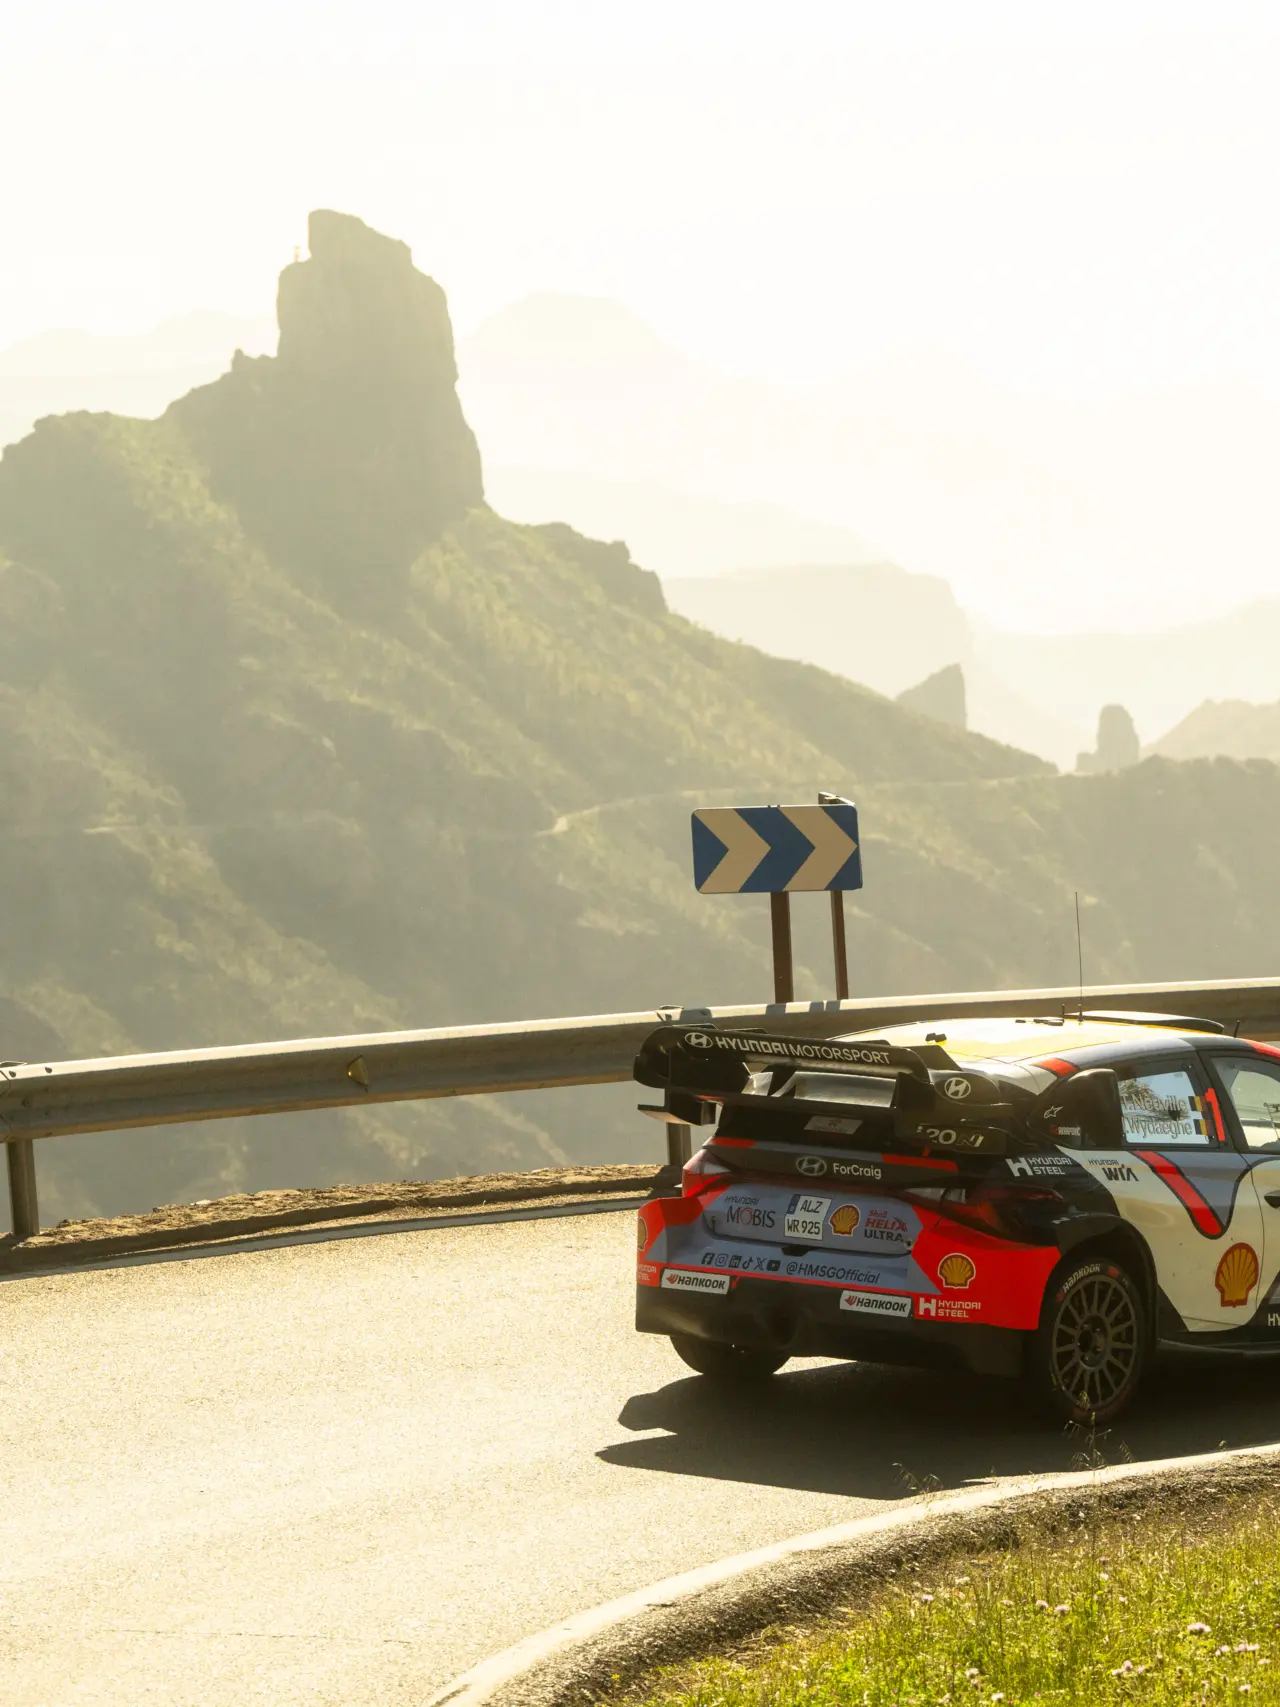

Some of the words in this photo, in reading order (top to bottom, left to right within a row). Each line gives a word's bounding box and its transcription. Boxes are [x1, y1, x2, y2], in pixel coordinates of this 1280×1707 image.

[716, 1036, 790, 1056] HYUNDAI
[789, 1043, 890, 1065] MOTORSPORT
[1204, 1088, 1226, 1141] 1
[1027, 1157, 1073, 1166] HYUNDAI
[1088, 1158, 1120, 1166] HYUNDAI
[833, 1162, 882, 1180] ForCraig
[1033, 1166, 1066, 1176] STEEL
[725, 1195, 759, 1206] HYUNDAI
[800, 1199, 824, 1214] ALZ
[726, 1206, 777, 1229] MOBIS
[868, 1209, 888, 1218] Shell
[787, 1218, 800, 1234] WR
[801, 1220, 821, 1236] 925
[864, 1216, 908, 1233] HELIX
[864, 1228, 904, 1243] ULTRA
[938, 1299, 982, 1310] HYUNDAI
[938, 1308, 969, 1319] STEEL
